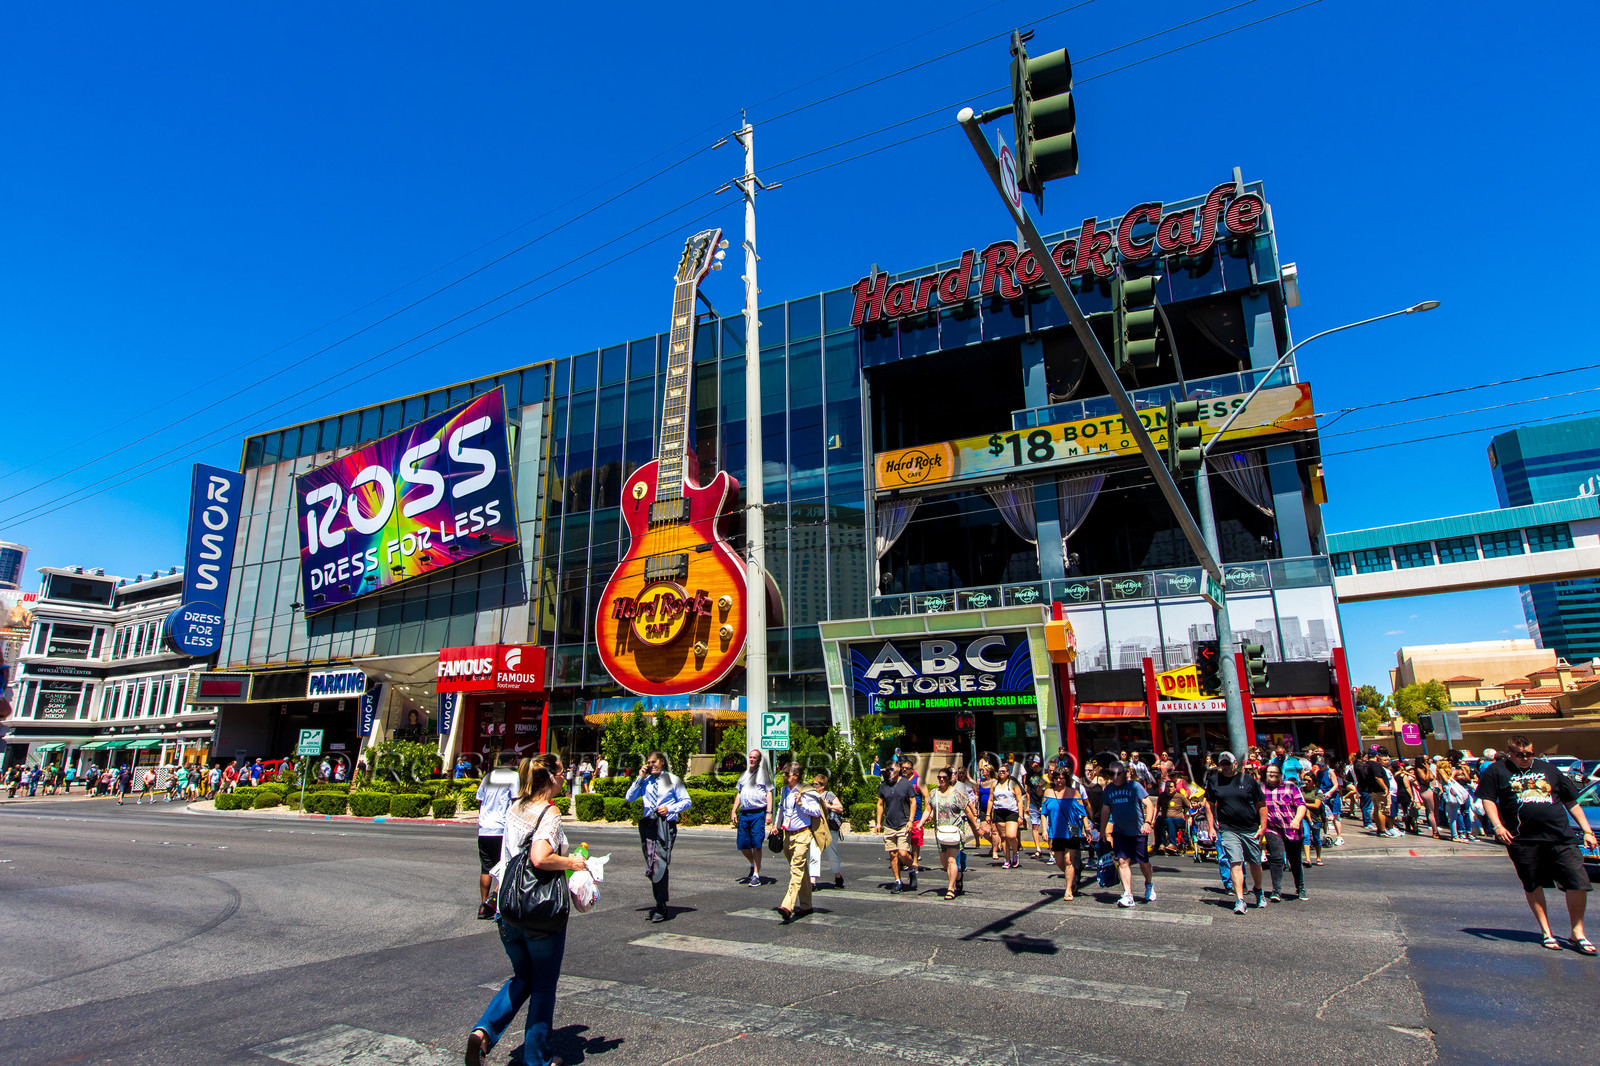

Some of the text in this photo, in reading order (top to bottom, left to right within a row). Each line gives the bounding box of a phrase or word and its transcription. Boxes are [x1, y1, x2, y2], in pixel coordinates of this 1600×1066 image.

[850, 182, 1265, 327] Hard Rock Cafe
[1064, 398, 1247, 441] BOTTOMESS
[988, 429, 1054, 467] $18
[886, 453, 942, 473] Hard Rock
[305, 415, 496, 555] ROSS
[907, 471, 922, 479] CAFE
[195, 475, 231, 590] ROSS
[310, 499, 501, 591] DRESS FOR LESS
[612, 589, 705, 619] Hard Rock
[184, 612, 221, 625] DRESS
[645, 622, 670, 634] CAFE
[189, 624, 212, 635] FOR
[184, 636, 213, 648] LESS
[438, 657, 493, 677] FAMOUS
[864, 635, 1008, 679] ABC
[309, 671, 366, 695] PARKING
[496, 681, 521, 689] footwear
[497, 672, 535, 684] FAMOUS
[878, 674, 997, 695] STORES
[889, 699, 920, 709] CLARITIN
[925, 698, 962, 708] BENADRYL
[968, 697, 995, 707] ZYRTEC
[996, 696, 1016, 706] SOLD
[1162, 701, 1226, 711] AMERICA'S DIN
[363, 694, 374, 733] ROSS
[1510, 772, 1546, 781] ALWAYS
[1516, 795, 1553, 804] HUSTLING
